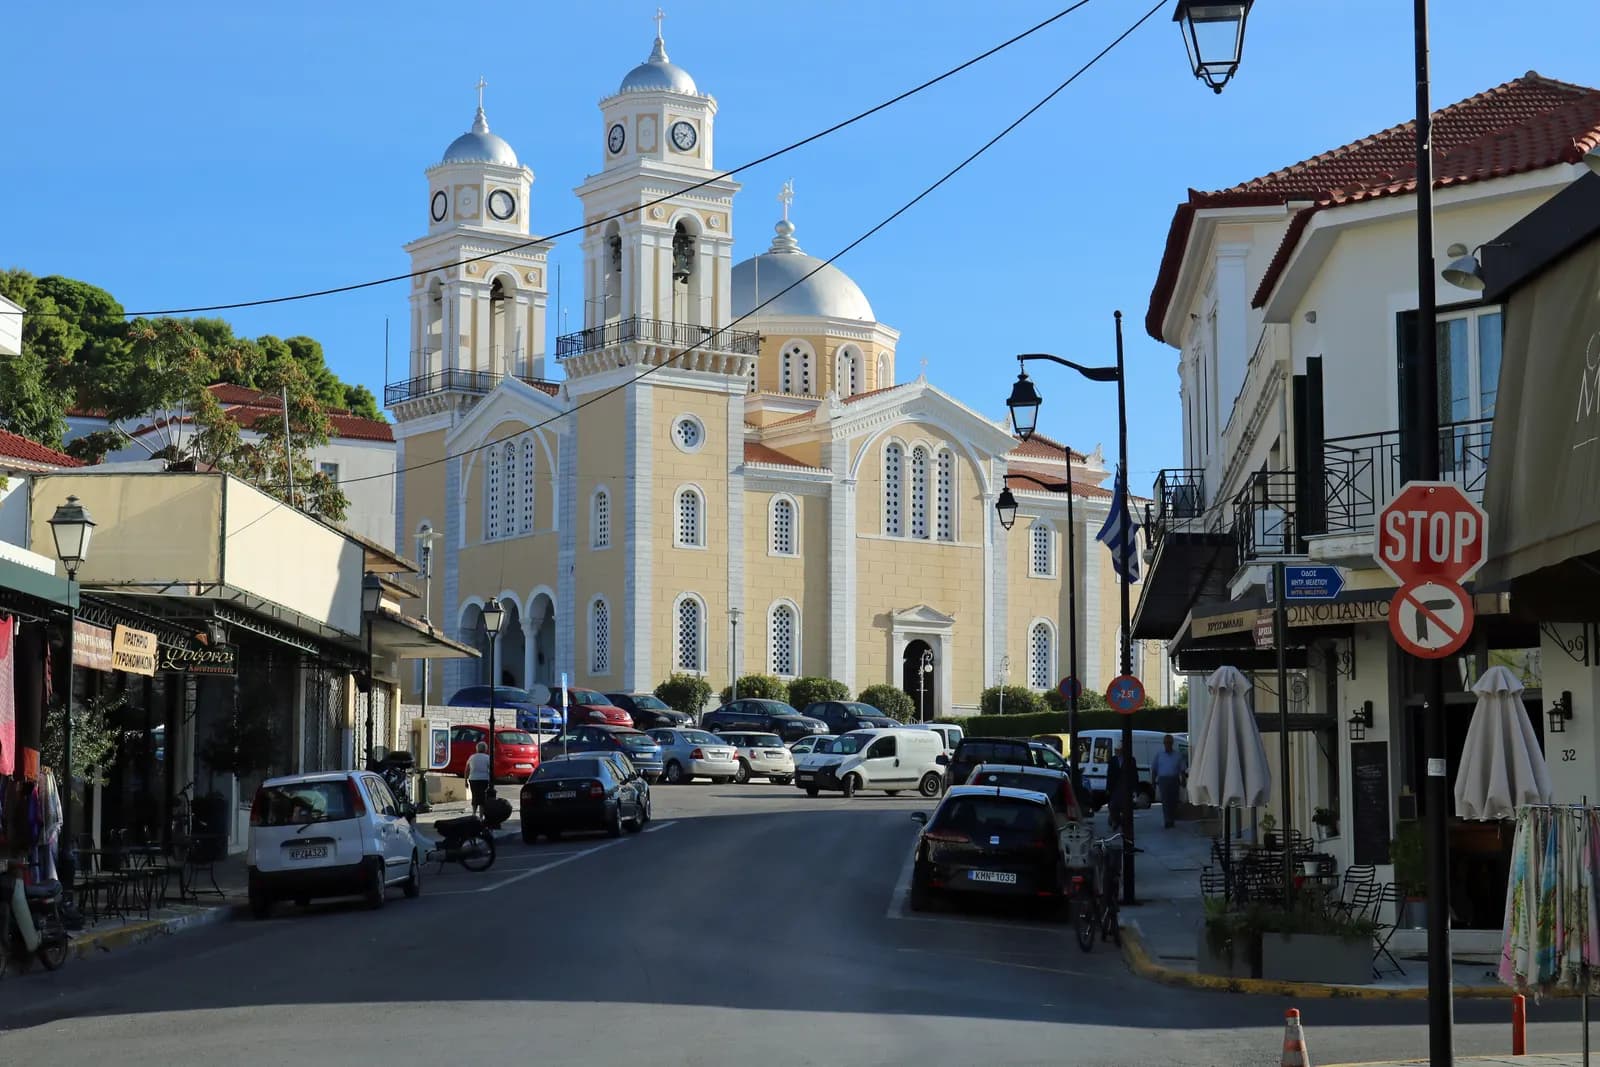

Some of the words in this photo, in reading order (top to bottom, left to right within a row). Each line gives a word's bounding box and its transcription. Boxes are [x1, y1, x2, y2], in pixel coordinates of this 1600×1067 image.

[1385, 510, 1477, 563] STOP
[123, 631, 149, 649] ΠΡΑΤΗΡΙΟ
[1562, 748, 1576, 761] 32
